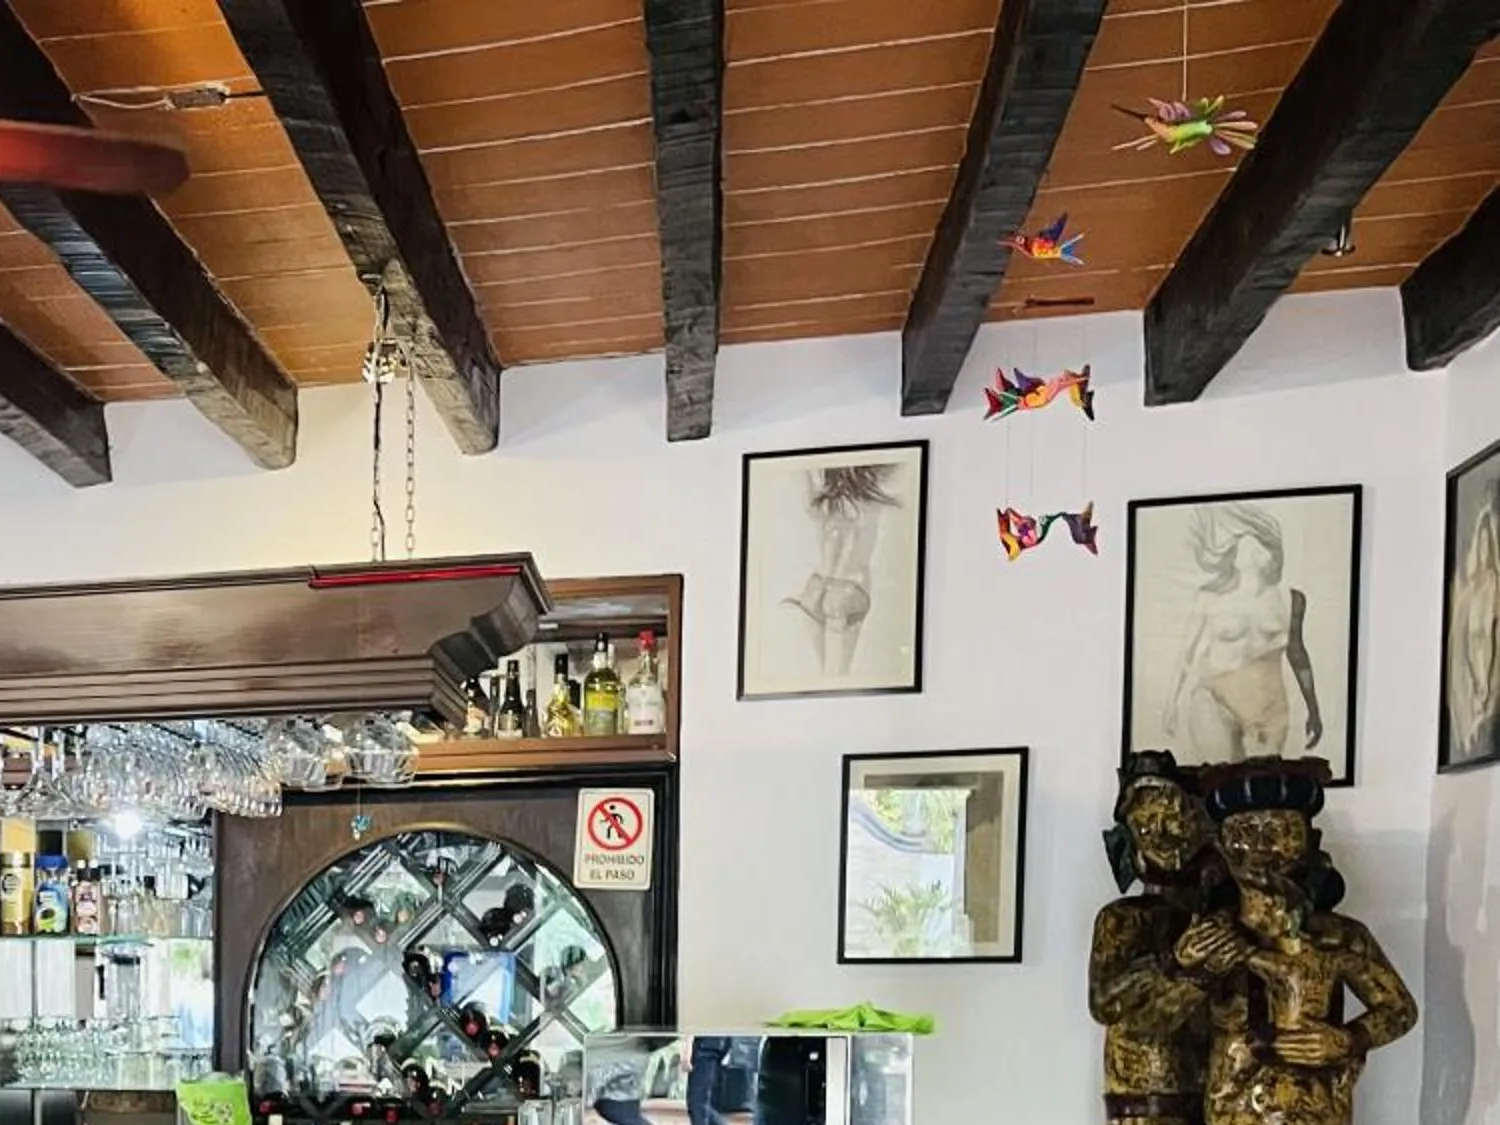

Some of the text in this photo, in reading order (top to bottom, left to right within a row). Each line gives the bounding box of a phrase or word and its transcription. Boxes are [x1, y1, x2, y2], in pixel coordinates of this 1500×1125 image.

[584, 853, 645, 866] PROHIBIDO
[589, 869, 636, 881] EL PASO
